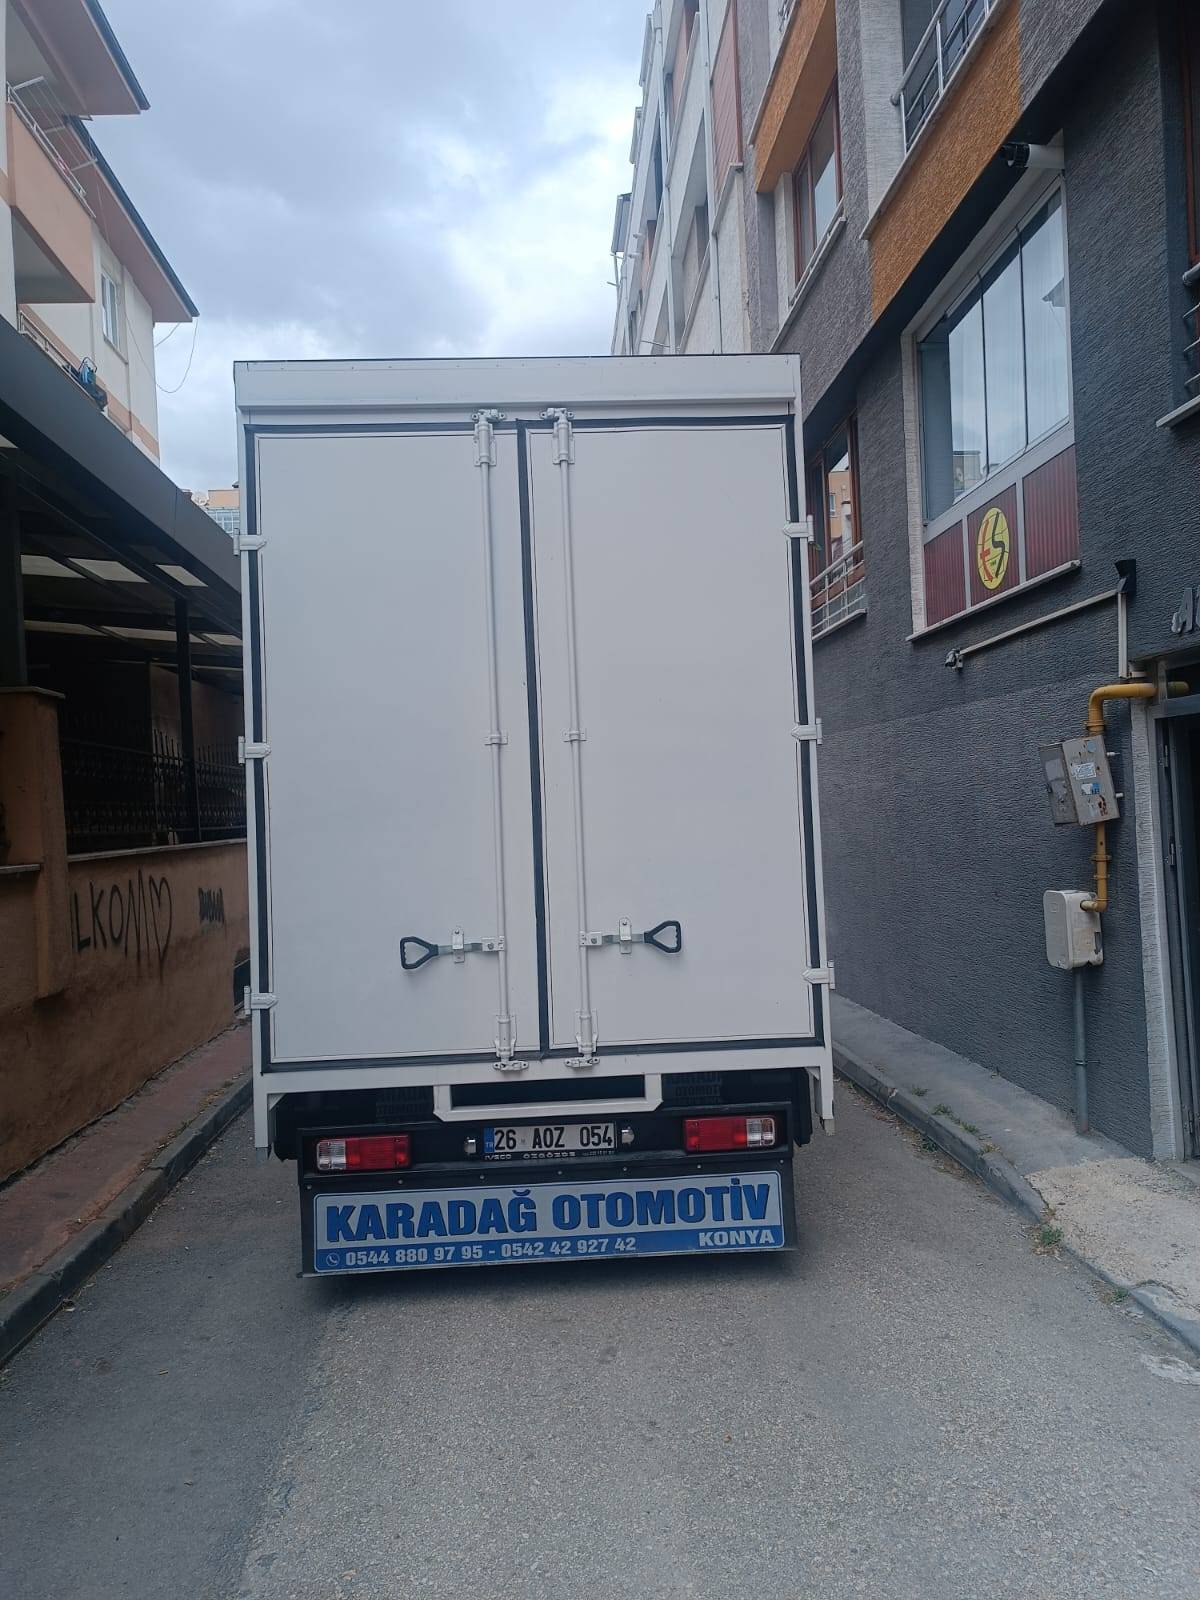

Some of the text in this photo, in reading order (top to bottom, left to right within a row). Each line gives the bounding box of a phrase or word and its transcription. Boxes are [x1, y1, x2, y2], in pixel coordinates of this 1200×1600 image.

[494, 1129, 516, 1150] 26
[532, 1126, 565, 1149] AOZ
[580, 1125, 613, 1147] 054
[326, 1177, 770, 1242] KARADAĞ OTOMOTİV
[346, 1251, 390, 1266] 0544
[396, 1249, 428, 1263] 880
[434, 1247, 455, 1260] 97
[461, 1245, 483, 1259] 95
[501, 1242, 544, 1258] 0542
[550, 1240, 572, 1255] 42
[576, 1238, 609, 1254] 927
[614, 1237, 636, 1252] 42
[699, 1229, 775, 1247] KONYA
